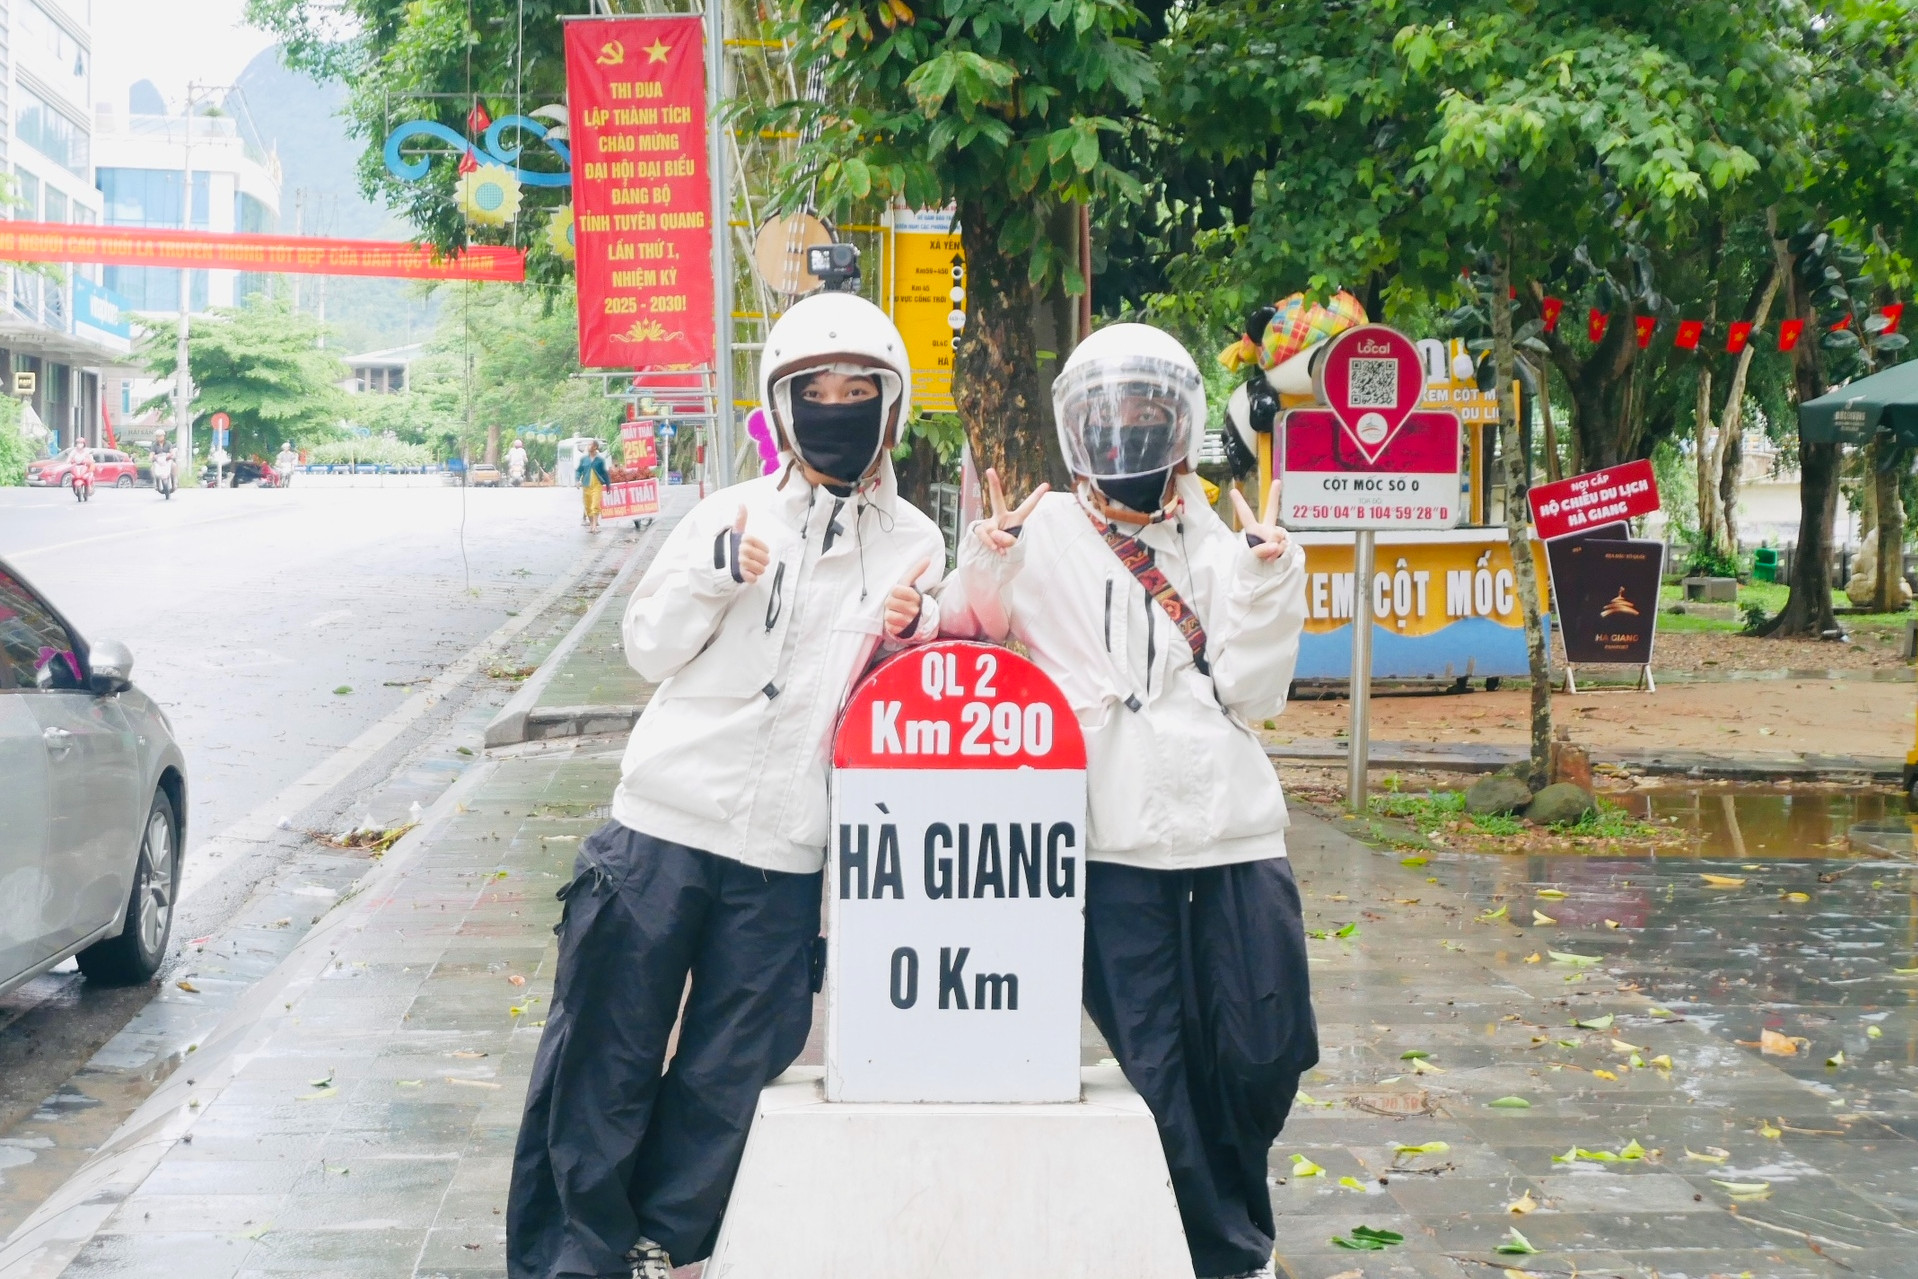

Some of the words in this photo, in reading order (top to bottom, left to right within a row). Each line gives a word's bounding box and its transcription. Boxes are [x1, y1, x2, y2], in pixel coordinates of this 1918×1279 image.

[610, 82, 632, 99] THI
[635, 81, 663, 98] ĐUA
[584, 106, 609, 130] LẬP
[613, 105, 658, 126] THÀNH
[661, 103, 691, 123] TÍCH
[598, 132, 635, 153] CHÀO
[639, 130, 680, 151] MỪNG
[584, 162, 608, 183] ĐẠI
[611, 158, 635, 181] HỘI
[638, 160, 661, 182] ĐẠI
[664, 154, 695, 177] BIỂU
[611, 179, 649, 206] ĐẢNG
[653, 183, 672, 207] BỘ
[579, 209, 610, 233] TỈNH
[613, 211, 657, 232] TUYÊN
[660, 211, 705, 231] QUANG
[68, 234, 97, 254] CAO
[607, 238, 635, 261] LẦN
[637, 238, 665, 260] THỨ
[667, 242, 680, 260] I,
[612, 267, 657, 291] NHIỆM
[660, 266, 678, 286] KỲ
[604, 297, 638, 314] 2025
[650, 294, 687, 313] 2030!
[1357, 341, 1391, 354] Local
[1323, 476, 1348, 492] CỘT
[1353, 475, 1383, 491] MỐC
[1388, 475, 1406, 491] SỐ
[1411, 480, 1420, 491] 0
[1590, 472, 1610, 487] CẤP
[1539, 499, 1560, 518] HỘ
[1560, 488, 1599, 511] CHIẾU
[1599, 486, 1618, 502] DU
[1619, 479, 1649, 499] LỊCH
[1568, 509, 1588, 527] HÀ
[1587, 501, 1629, 522] GIANG
[1372, 557, 1430, 628] CỘT
[1446, 549, 1514, 617] MỐC
[921, 651, 964, 700] QL
[974, 653, 998, 698] 2
[871, 700, 951, 755] Km
[960, 701, 1054, 756] 290
[839, 802, 905, 900] HÀ
[923, 821, 1076, 900] GIANG
[889, 946, 919, 1010] 0
[938, 946, 1019, 1011] Km
